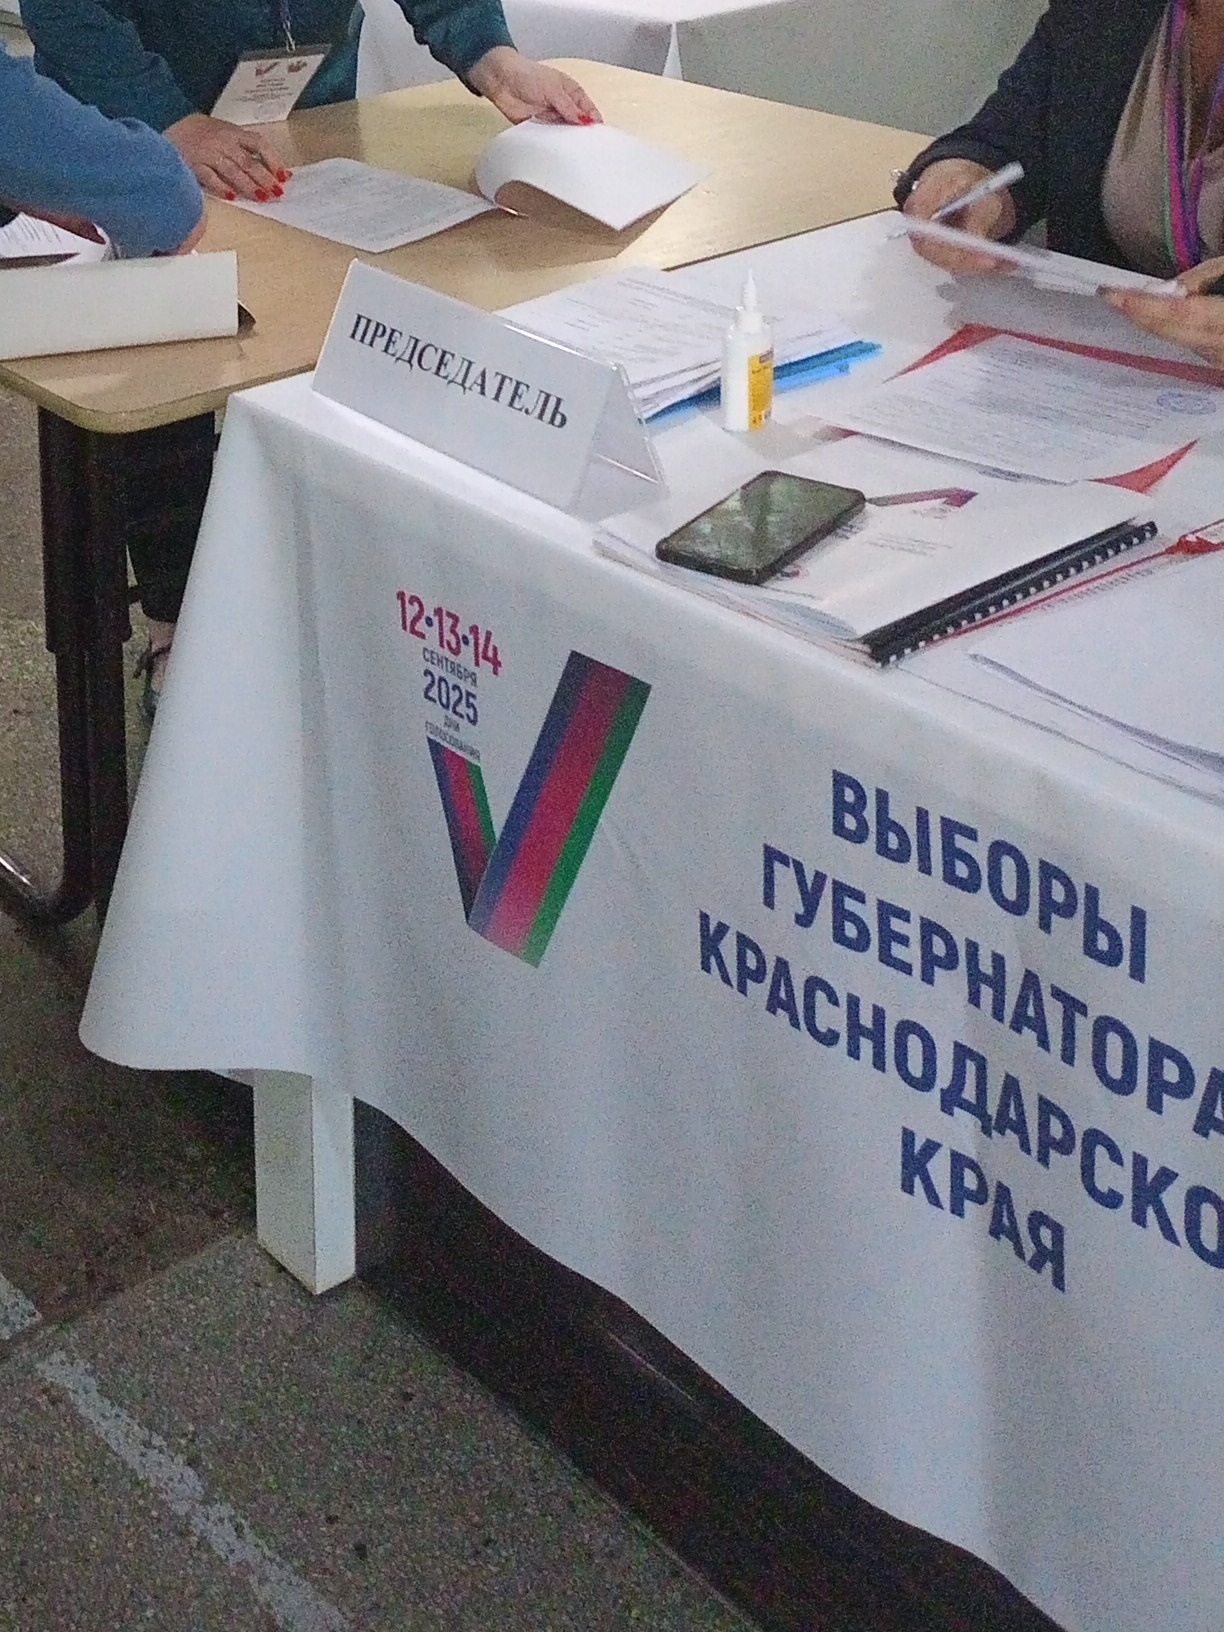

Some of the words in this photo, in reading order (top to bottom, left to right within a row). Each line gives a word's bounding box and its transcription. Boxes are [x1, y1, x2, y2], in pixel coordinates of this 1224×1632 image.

[349, 313, 568, 430] ПРЕДСЕДАТЕЛЬ
[422, 646, 478, 688] СЕНТЯБРЯ
[423, 669, 479, 727] 2025
[832, 769, 1148, 984] ВЫБОРЫ
[762, 843, 1224, 1139] ГУБЕРНАТОРА
[900, 1125, 1067, 1294] КРАЯ
